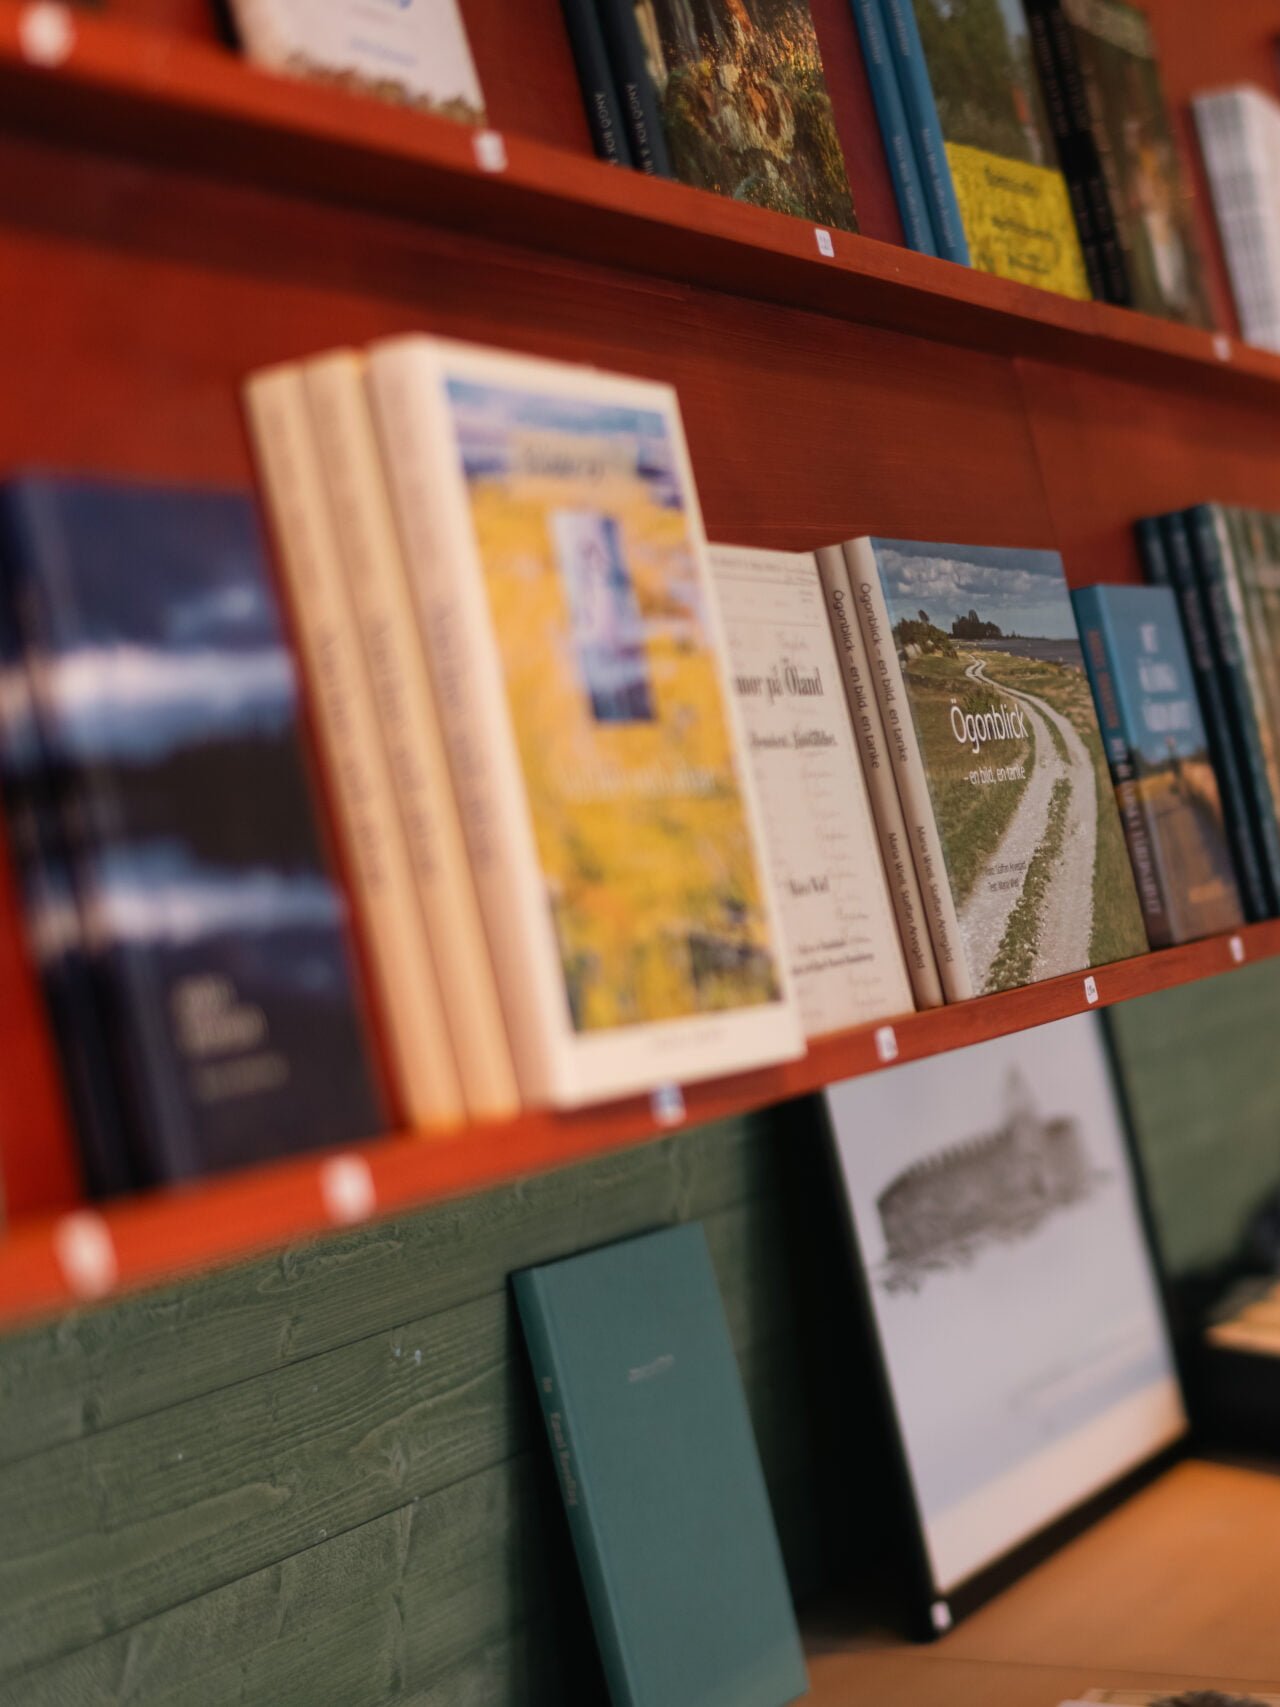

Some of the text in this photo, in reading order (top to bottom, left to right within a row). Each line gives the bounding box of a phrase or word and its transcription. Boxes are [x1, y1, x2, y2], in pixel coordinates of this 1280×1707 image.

[832, 588, 856, 652] Ögonblick
[860, 583, 882, 648] Ögonblick
[765, 664, 784, 706] på
[782, 658, 825, 698] Öland
[850, 665, 861, 683] en
[878, 658, 888, 676] en
[861, 715, 872, 732] en
[889, 708, 899, 725] en
[950, 697, 1029, 754] Ögonblick
[863, 734, 880, 769] tanke
[893, 727, 909, 763] tanke
[968, 768, 980, 785] en
[978, 765, 997, 786] bild,
[996, 766, 1007, 782] en
[1005, 763, 1027, 781] tanke
